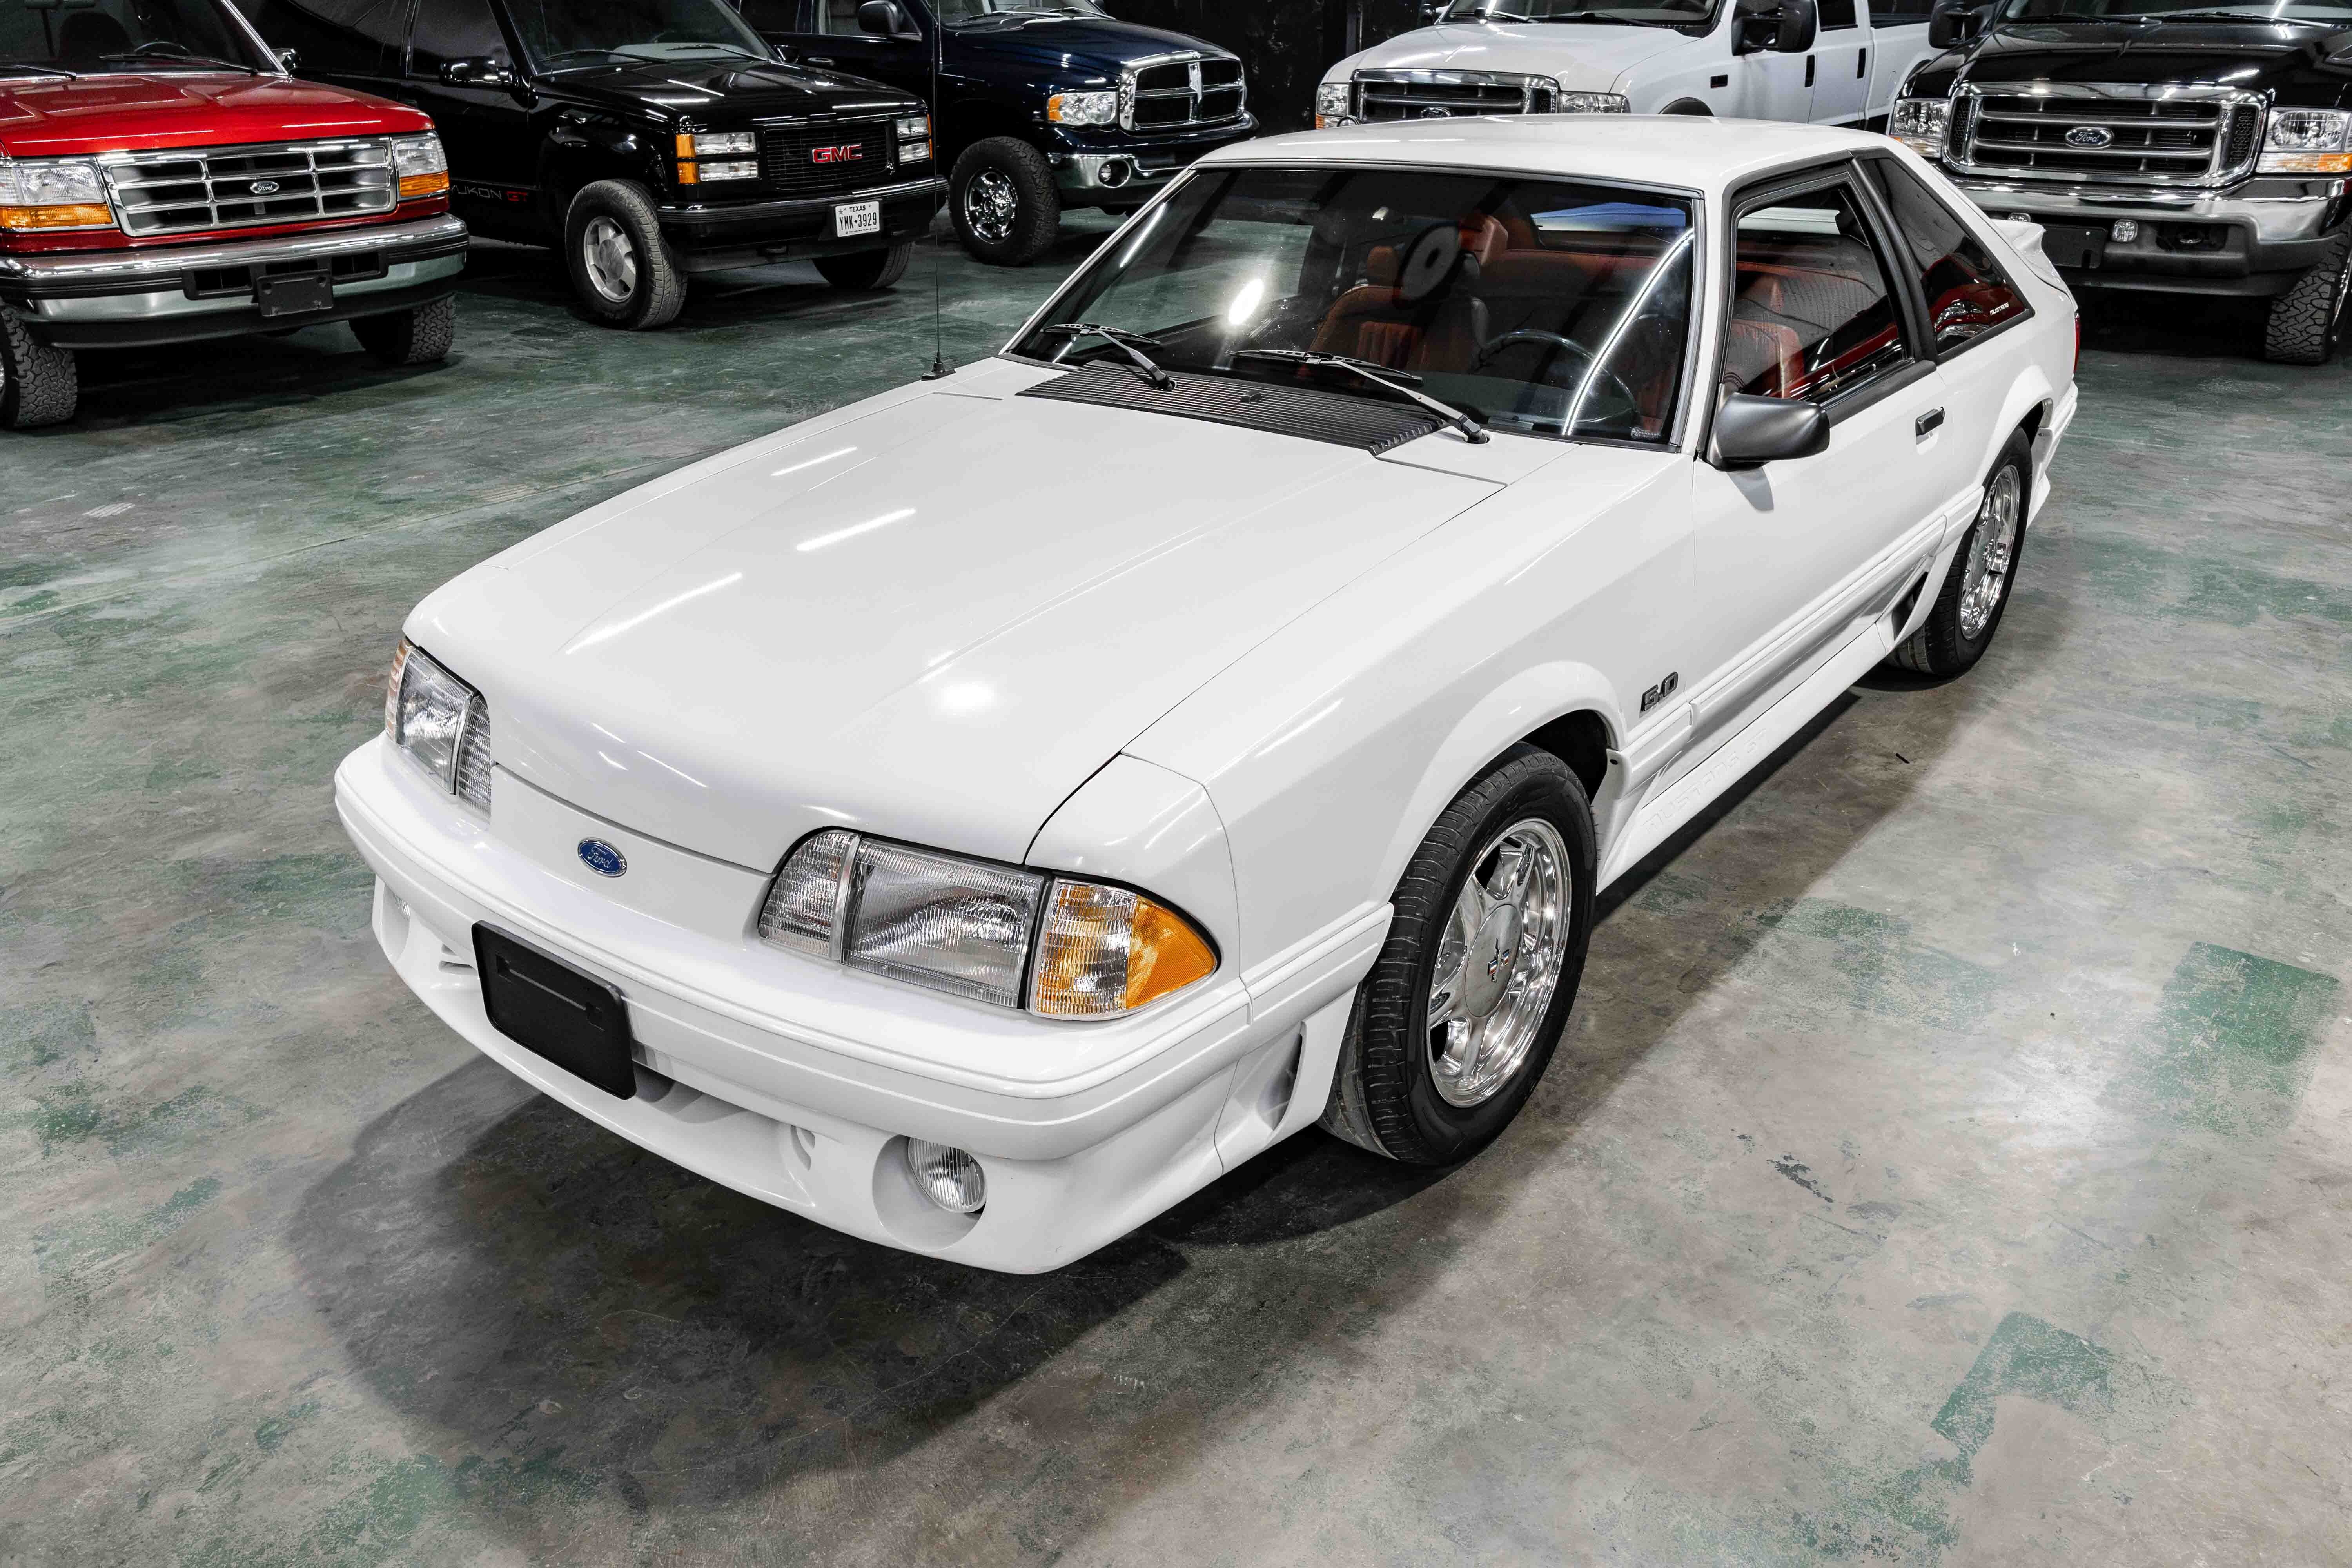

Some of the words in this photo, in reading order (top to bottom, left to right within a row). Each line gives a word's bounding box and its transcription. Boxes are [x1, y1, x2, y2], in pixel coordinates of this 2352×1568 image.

[2075, 131, 2100, 142] Ford
[812, 143, 862, 163] GMC
[506, 191, 528, 201] GT
[849, 205, 866, 213] TEXAS
[1989, 302, 2009, 316] MUSTANG
[1641, 671, 1679, 712] 5.0
[587, 846, 613, 869] Ford
